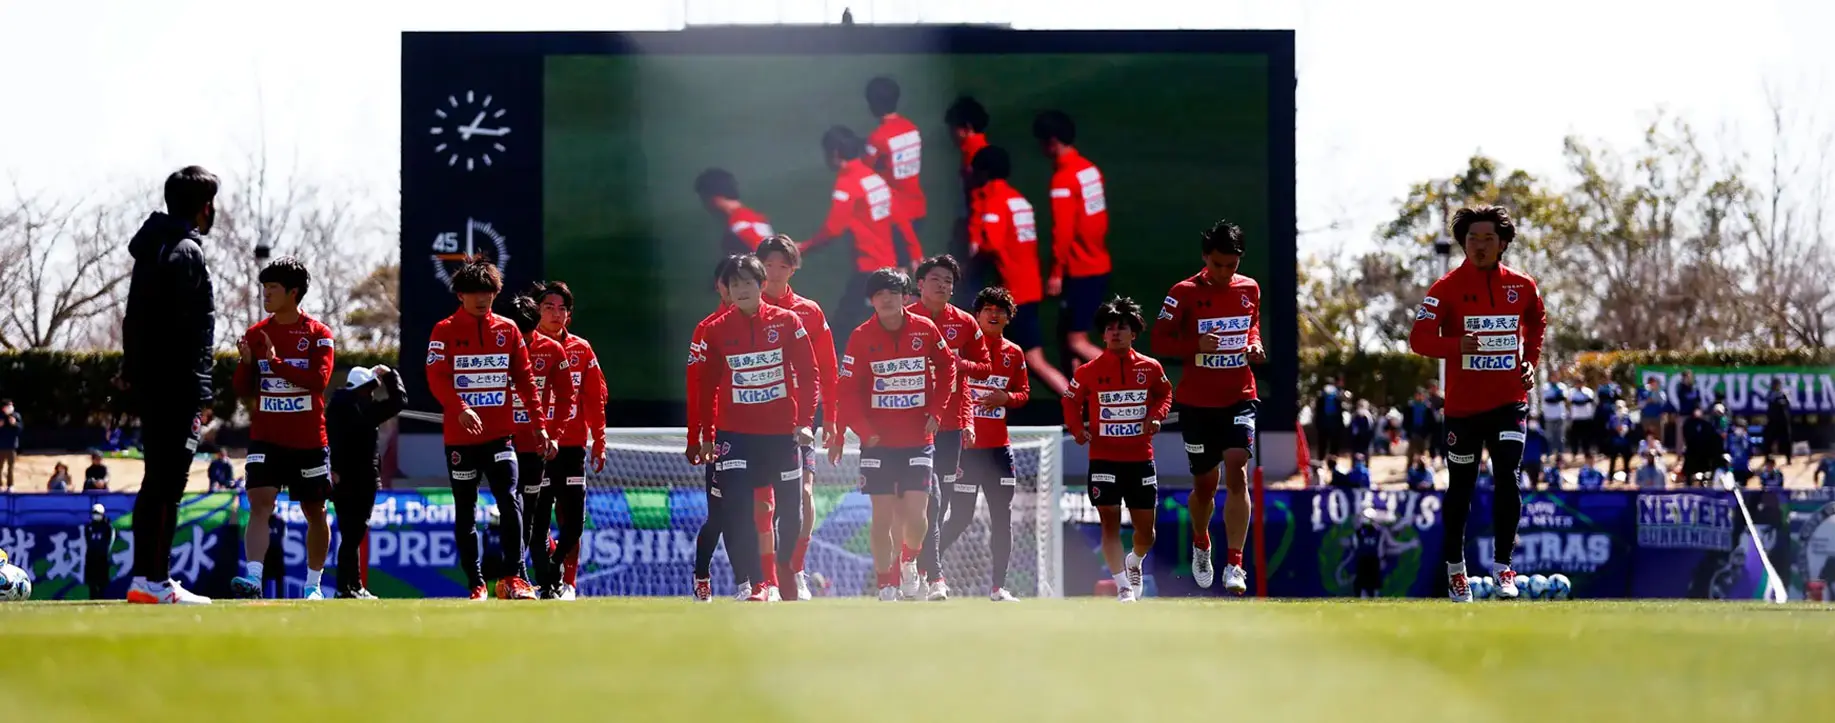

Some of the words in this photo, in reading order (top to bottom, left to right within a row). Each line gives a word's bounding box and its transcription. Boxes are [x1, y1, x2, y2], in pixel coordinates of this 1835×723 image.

[432, 231, 459, 252] 45
[1466, 317, 1518, 330] 福島民友
[455, 356, 508, 368] 福島民友
[728, 351, 782, 368] 福島民友
[873, 359, 924, 374] 福島民友
[1100, 391, 1146, 403] 福島民友
